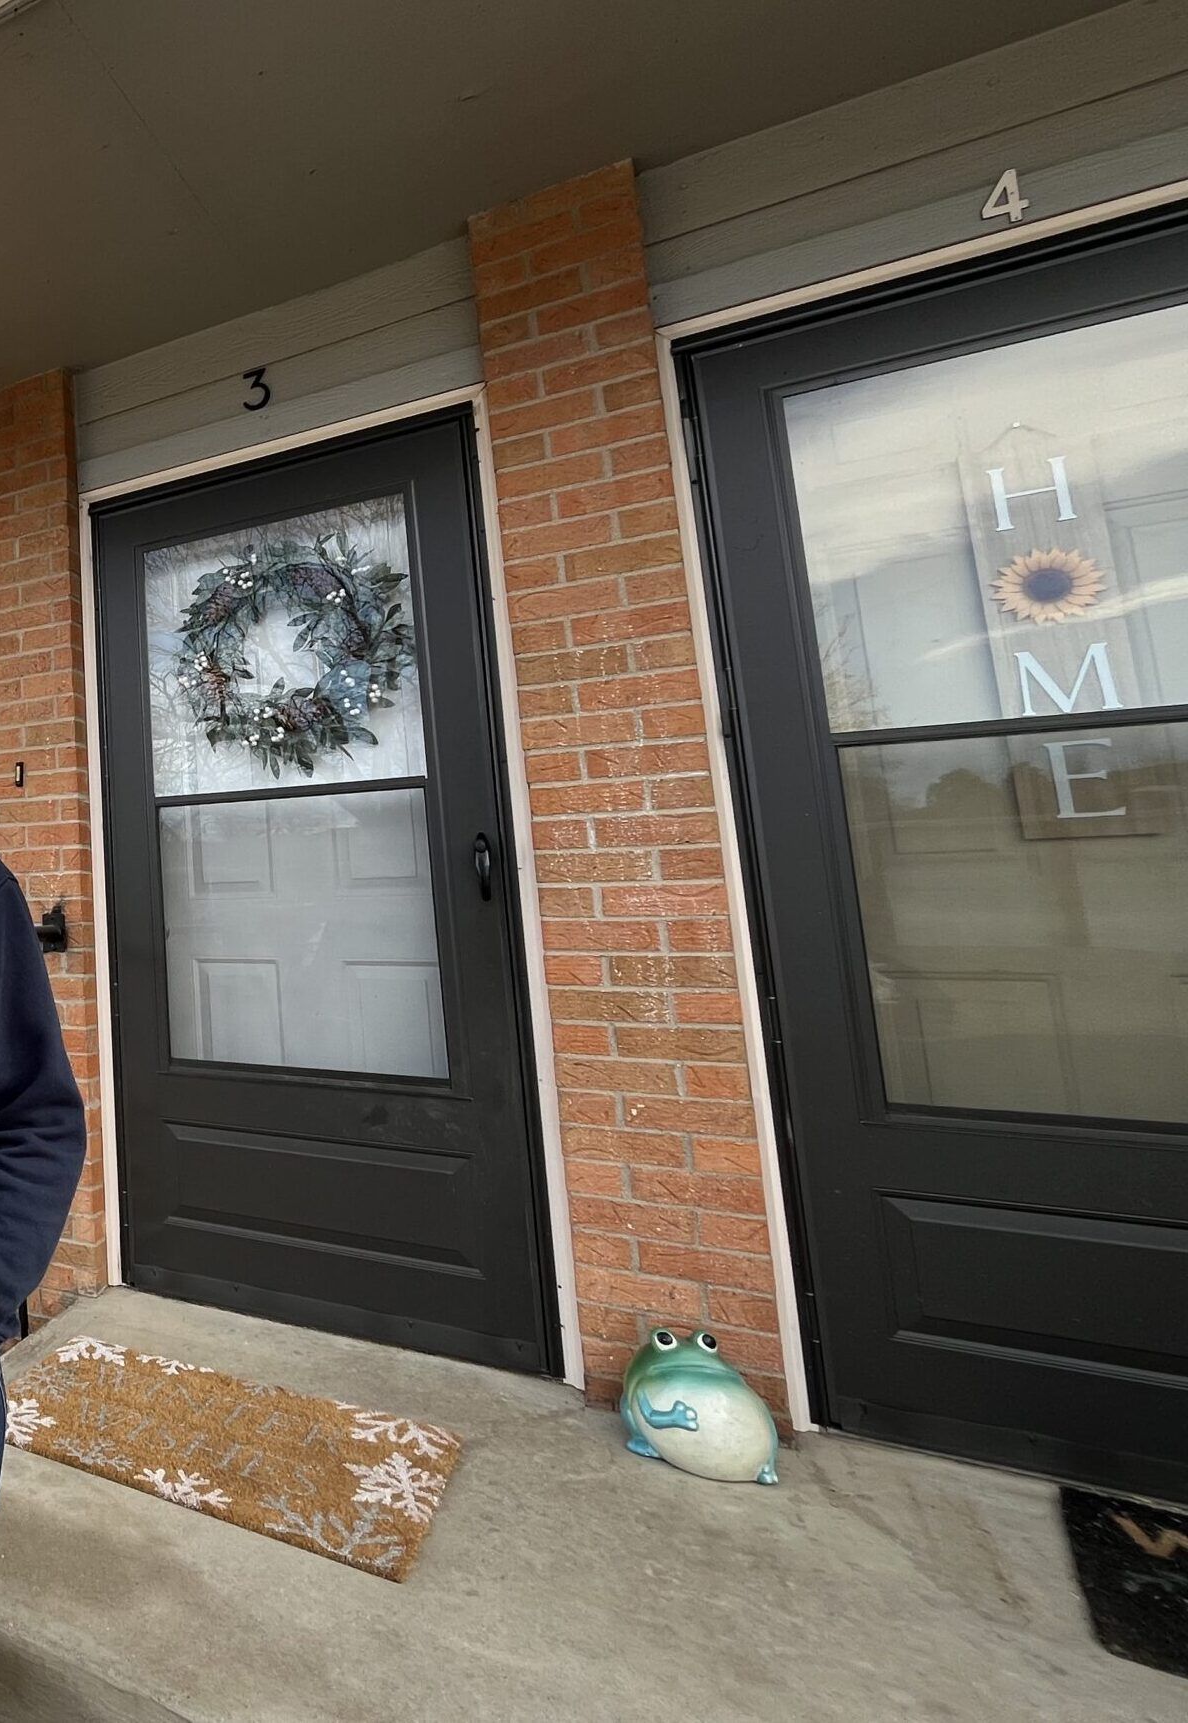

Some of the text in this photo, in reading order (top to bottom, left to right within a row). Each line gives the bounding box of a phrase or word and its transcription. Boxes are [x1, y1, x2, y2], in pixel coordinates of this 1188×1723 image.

[981, 168, 1030, 223] 4
[243, 367, 271, 411] 3
[986, 455, 1127, 820] HME
